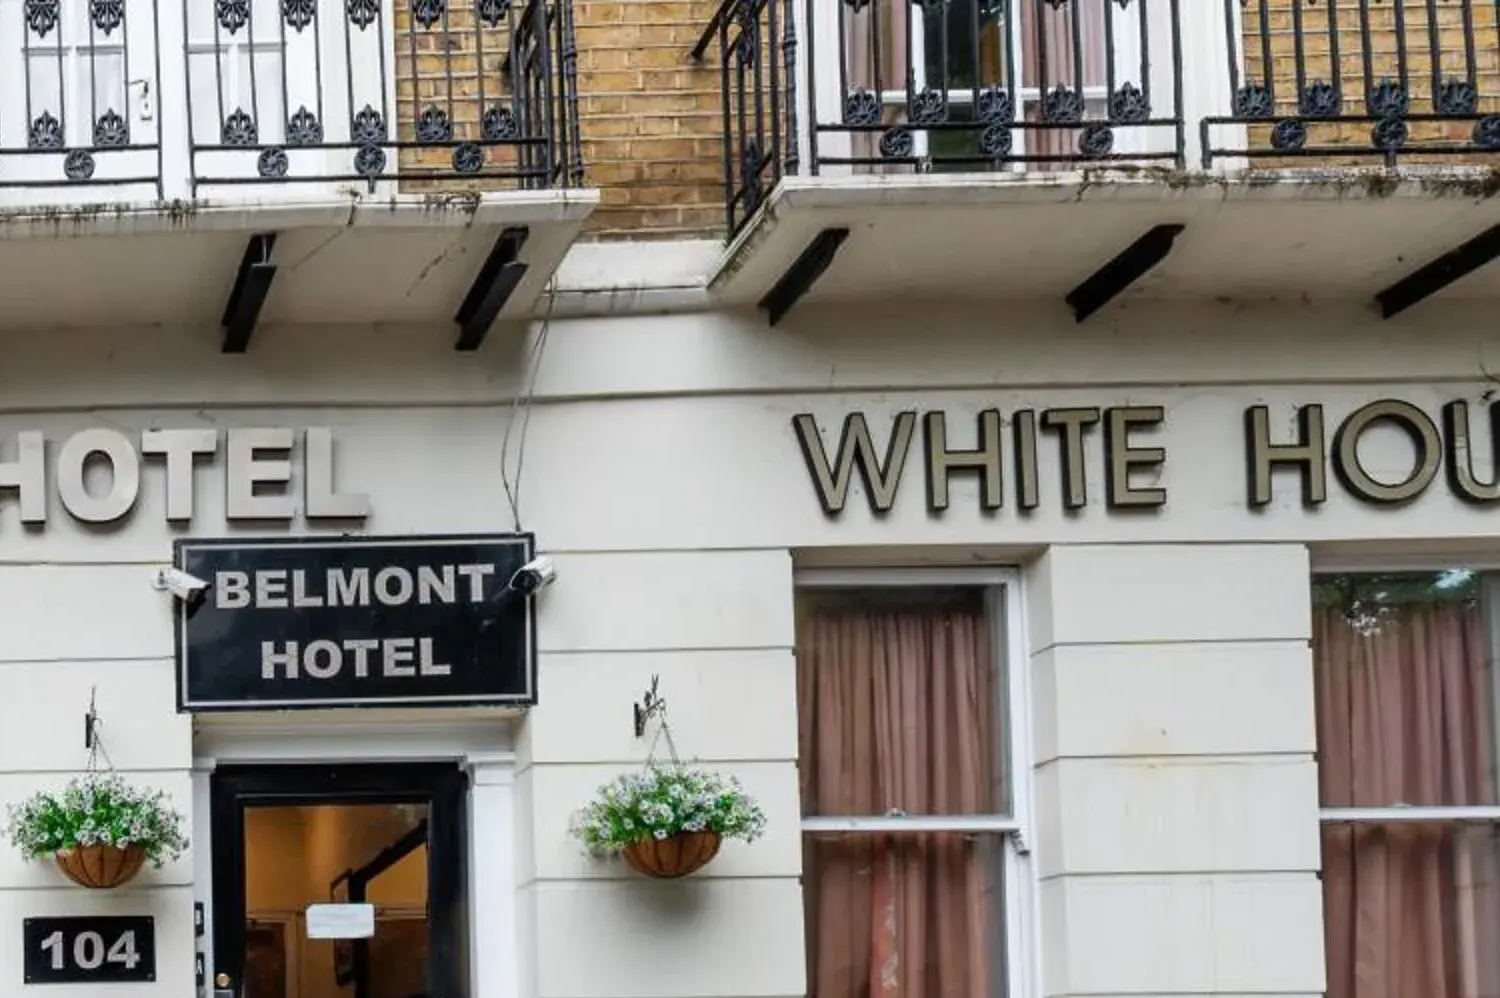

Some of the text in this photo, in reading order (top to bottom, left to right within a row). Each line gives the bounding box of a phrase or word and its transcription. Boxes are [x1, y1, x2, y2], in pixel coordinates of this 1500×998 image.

[794, 404, 1168, 514] WHITE
[214, 563, 495, 609] BELMONT
[260, 637, 452, 679] HOTEL
[40, 929, 141, 970] 104
